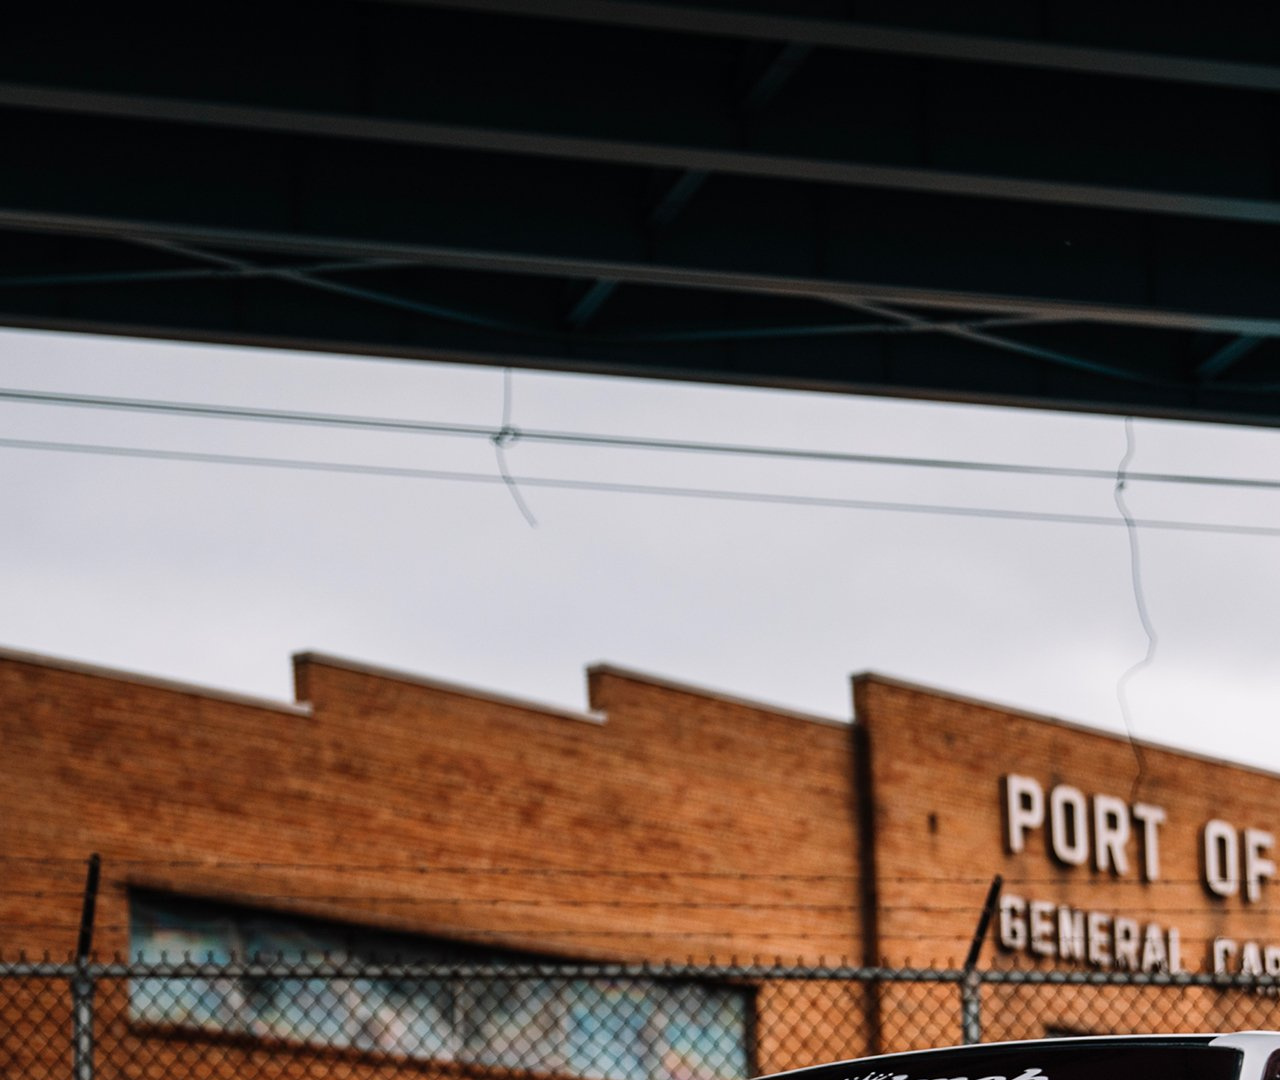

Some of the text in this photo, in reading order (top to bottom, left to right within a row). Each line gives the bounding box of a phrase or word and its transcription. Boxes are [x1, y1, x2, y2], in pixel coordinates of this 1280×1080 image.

[1004, 773, 1166, 882] PORT
[1203, 818, 1277, 903] OF
[997, 894, 1183, 976] GENERAL
